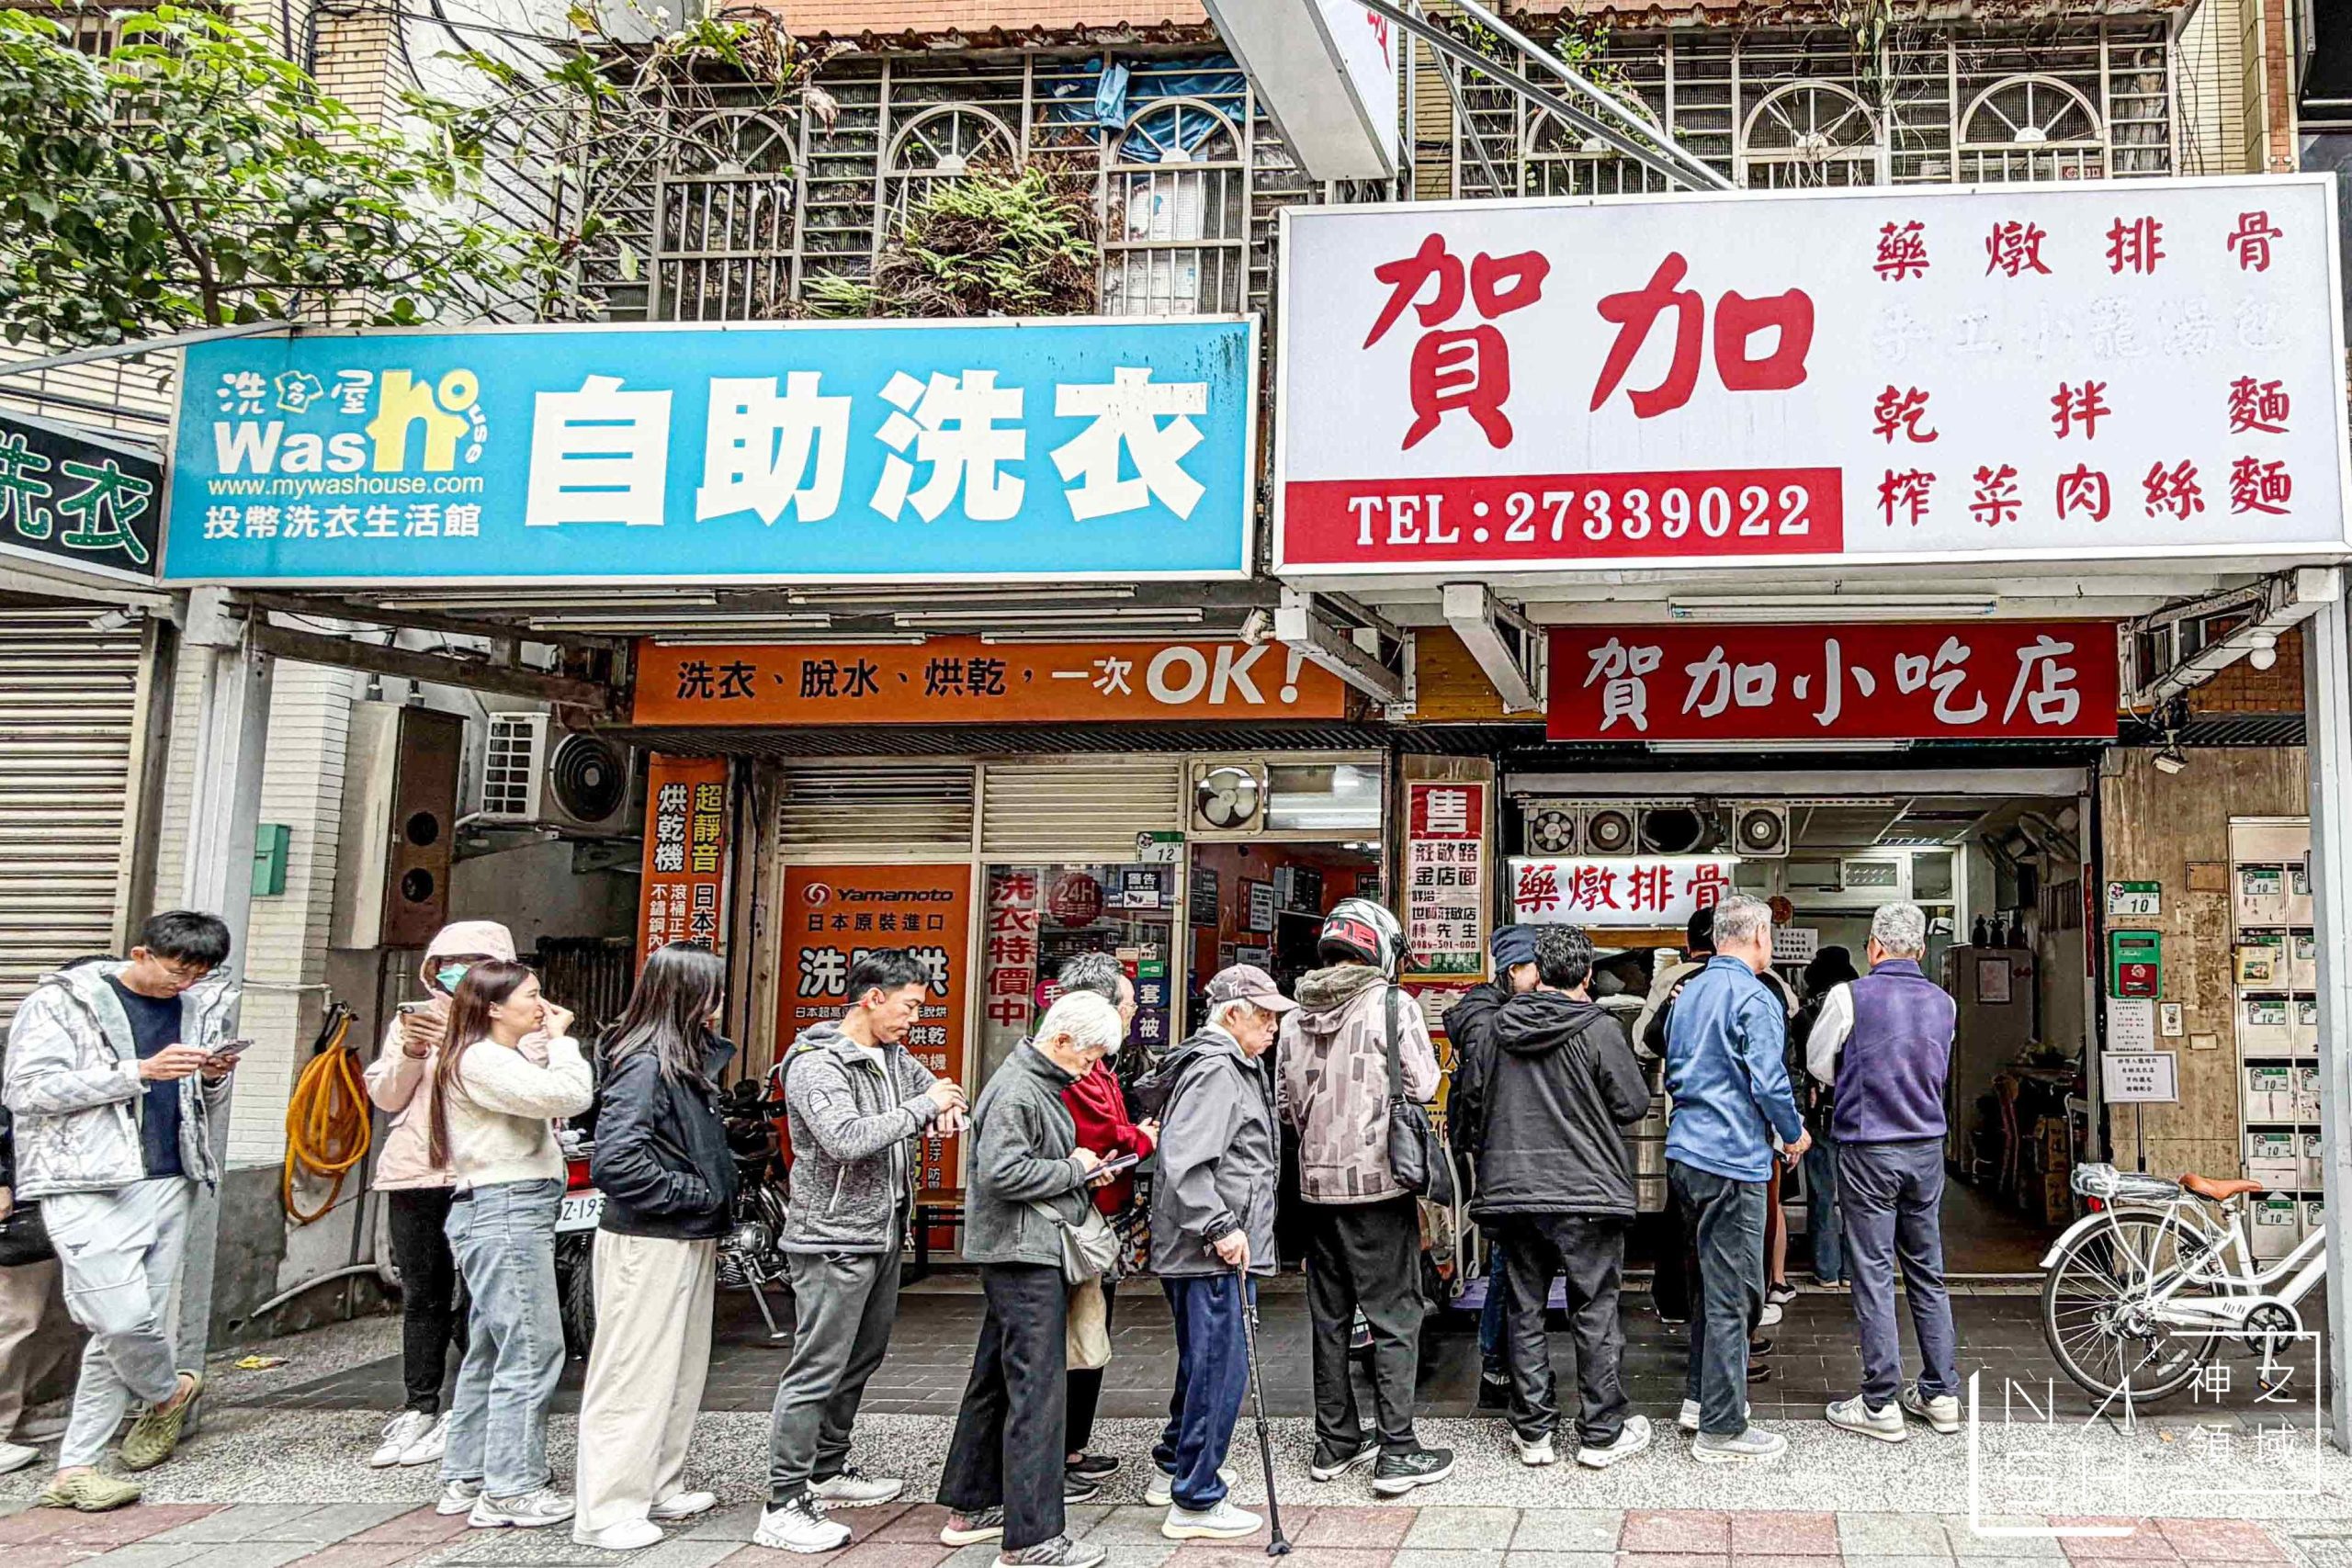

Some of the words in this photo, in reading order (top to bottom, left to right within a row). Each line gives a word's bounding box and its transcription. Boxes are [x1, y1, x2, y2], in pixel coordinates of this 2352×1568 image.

[1872, 210, 2282, 281] 藥燉排骨
[1363, 233, 1815, 450] 賀加
[1872, 376, 2290, 444] 乾拌麵
[525, 367, 1208, 526] 自助洗衣
[208, 474, 483, 499] www.mywashouse.com
[1877, 455, 2292, 527] 榨菜肉絲麵
[204, 503, 481, 539] 投幣洗衣生活館
[1583, 635, 2080, 732] 賀加小吃店
[1427, 789, 1467, 833] 售
[655, 784, 688, 872] 烘乾機
[693, 784, 723, 872] 超靜音
[1158, 848, 1175, 862] 12
[1415, 843, 1477, 863] 莊敬路
[1415, 867, 1476, 886] 金店面
[1514, 863, 1731, 913] 藥燉排骨
[2256, 883, 2268, 893] 10
[837, 888, 954, 902] Yamamoto
[1057, 882, 1096, 902] 24H
[2131, 898, 2150, 913] 10
[808, 913, 944, 932] 日本原裝進口
[987, 874, 1035, 1028] 洗衣特價中
[2262, 1013, 2274, 1023] 10
[2264, 1080, 2277, 1089] 10
[2267, 1145, 2279, 1156] 10
[2270, 1213, 2282, 1224] 10
